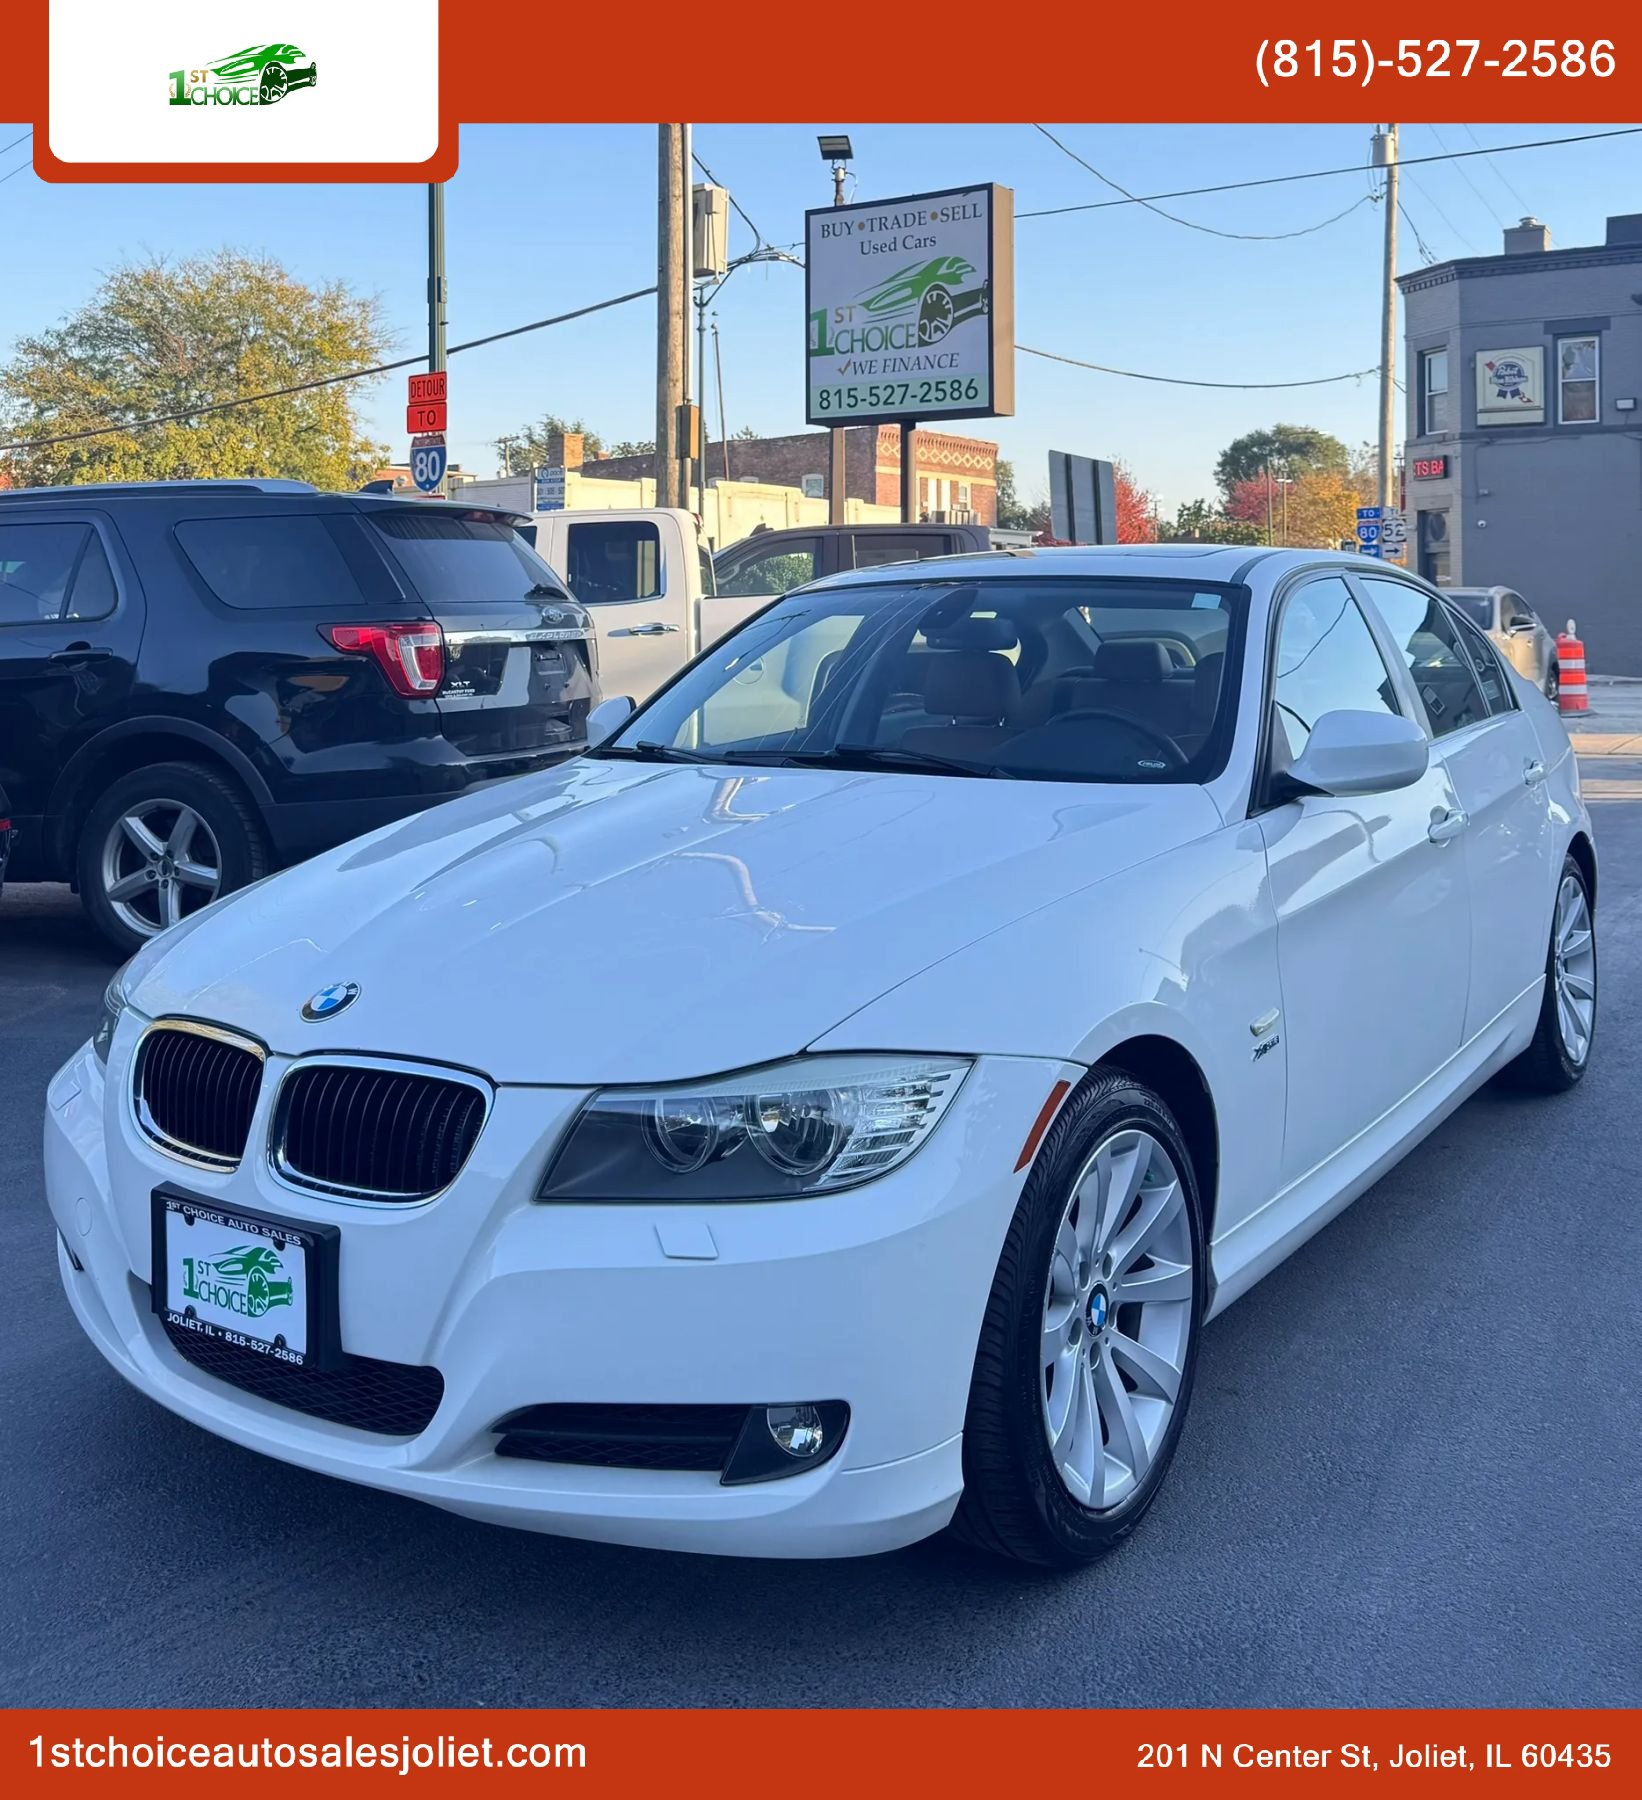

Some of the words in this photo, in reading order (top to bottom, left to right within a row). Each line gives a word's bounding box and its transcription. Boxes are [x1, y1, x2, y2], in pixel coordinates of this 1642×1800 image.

[821, 220, 855, 239] BUY
[866, 210, 927, 233] TRADE
[939, 203, 983, 223] SELL
[860, 238, 898, 256] Used
[902, 234, 937, 251] Cars
[834, 323, 918, 355] CHOICE
[853, 359, 878, 376] WE
[882, 352, 960, 374] FINANCE
[410, 378, 445, 399] DETOUR
[819, 377, 979, 411] 815-527-2586
[417, 409, 436, 427] TO
[415, 450, 440, 483] 80
[1362, 509, 1375, 517] TO
[1360, 527, 1377, 539] 80
[1384, 523, 1405, 537] 52
[450, 680, 470, 688] XLT
[166, 1200, 181, 1211] 1ST
[183, 1205, 225, 1226] CHOICE
[227, 1218, 259, 1235] AUTO
[262, 1227, 302, 1245] SALES
[199, 1280, 248, 1315] CHOICE
[167, 1312, 204, 1333] JOLIET,
[205, 1324, 215, 1337] IL
[225, 1331, 304, 1366] 815-527-2586
